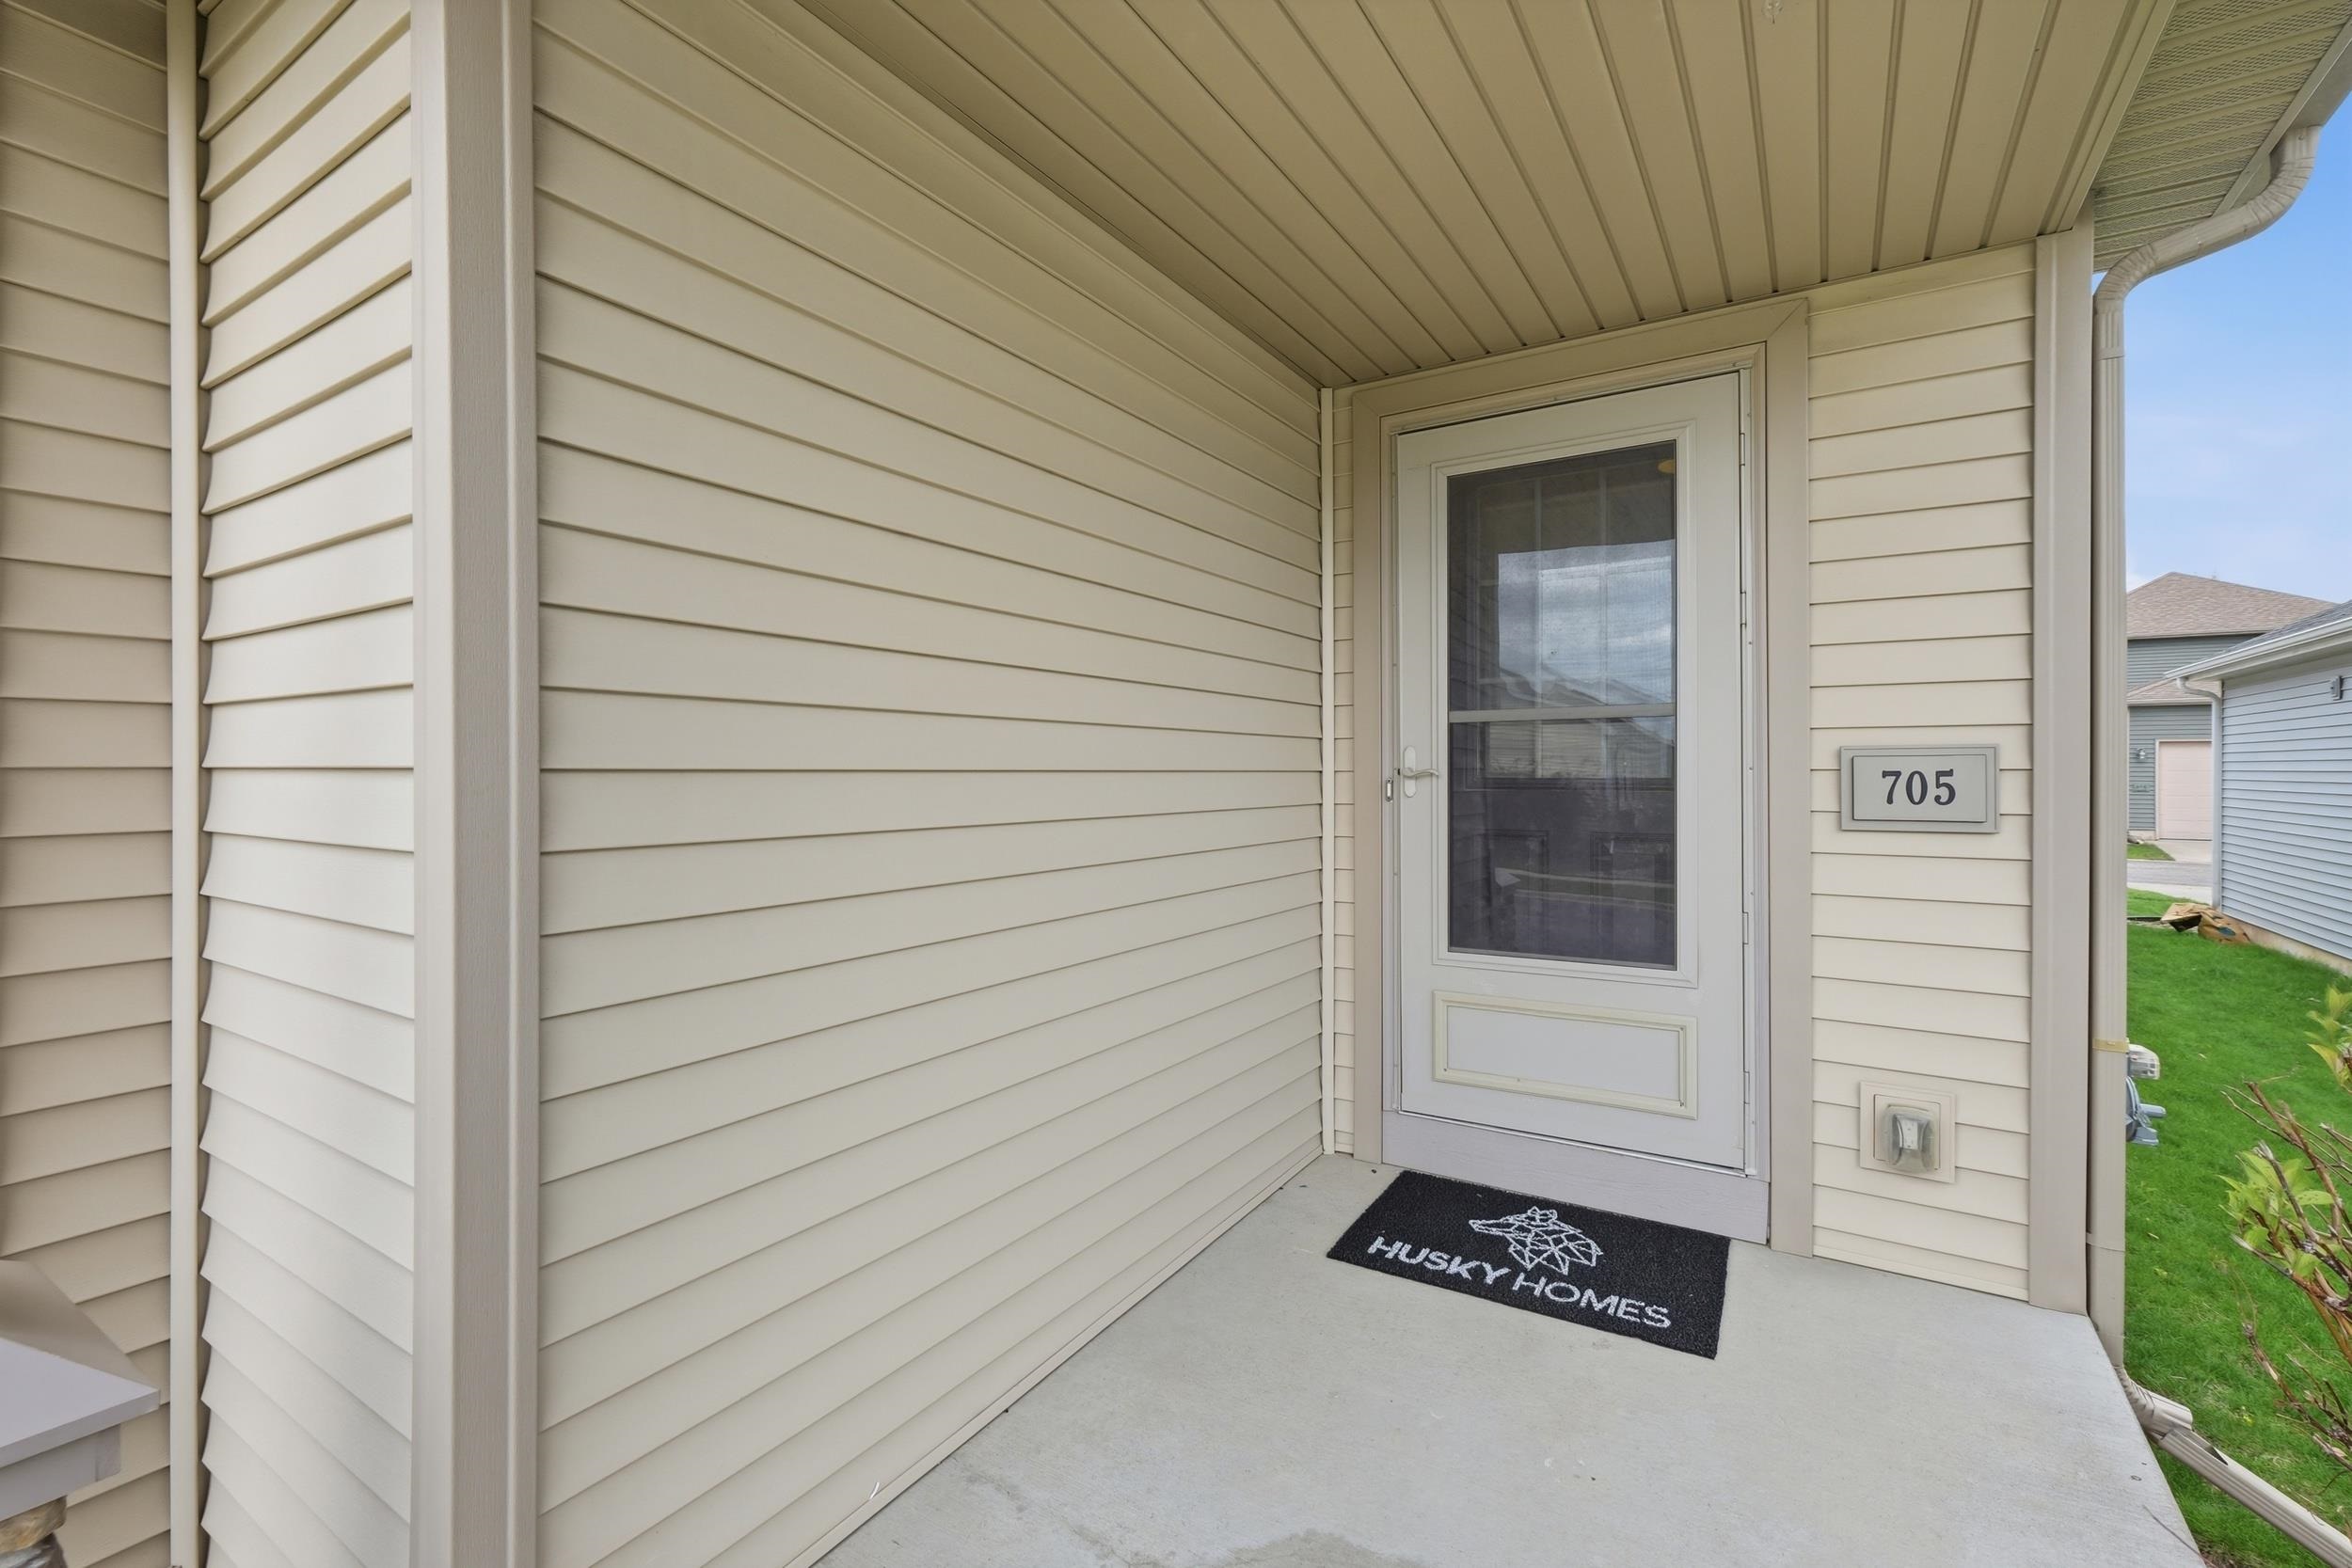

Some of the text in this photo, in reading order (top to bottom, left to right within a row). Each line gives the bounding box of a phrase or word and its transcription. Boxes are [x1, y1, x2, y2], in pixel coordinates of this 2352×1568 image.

[1882, 768, 1956, 805] 705
[1368, 1235, 1671, 1328] HUSKY HOMES
